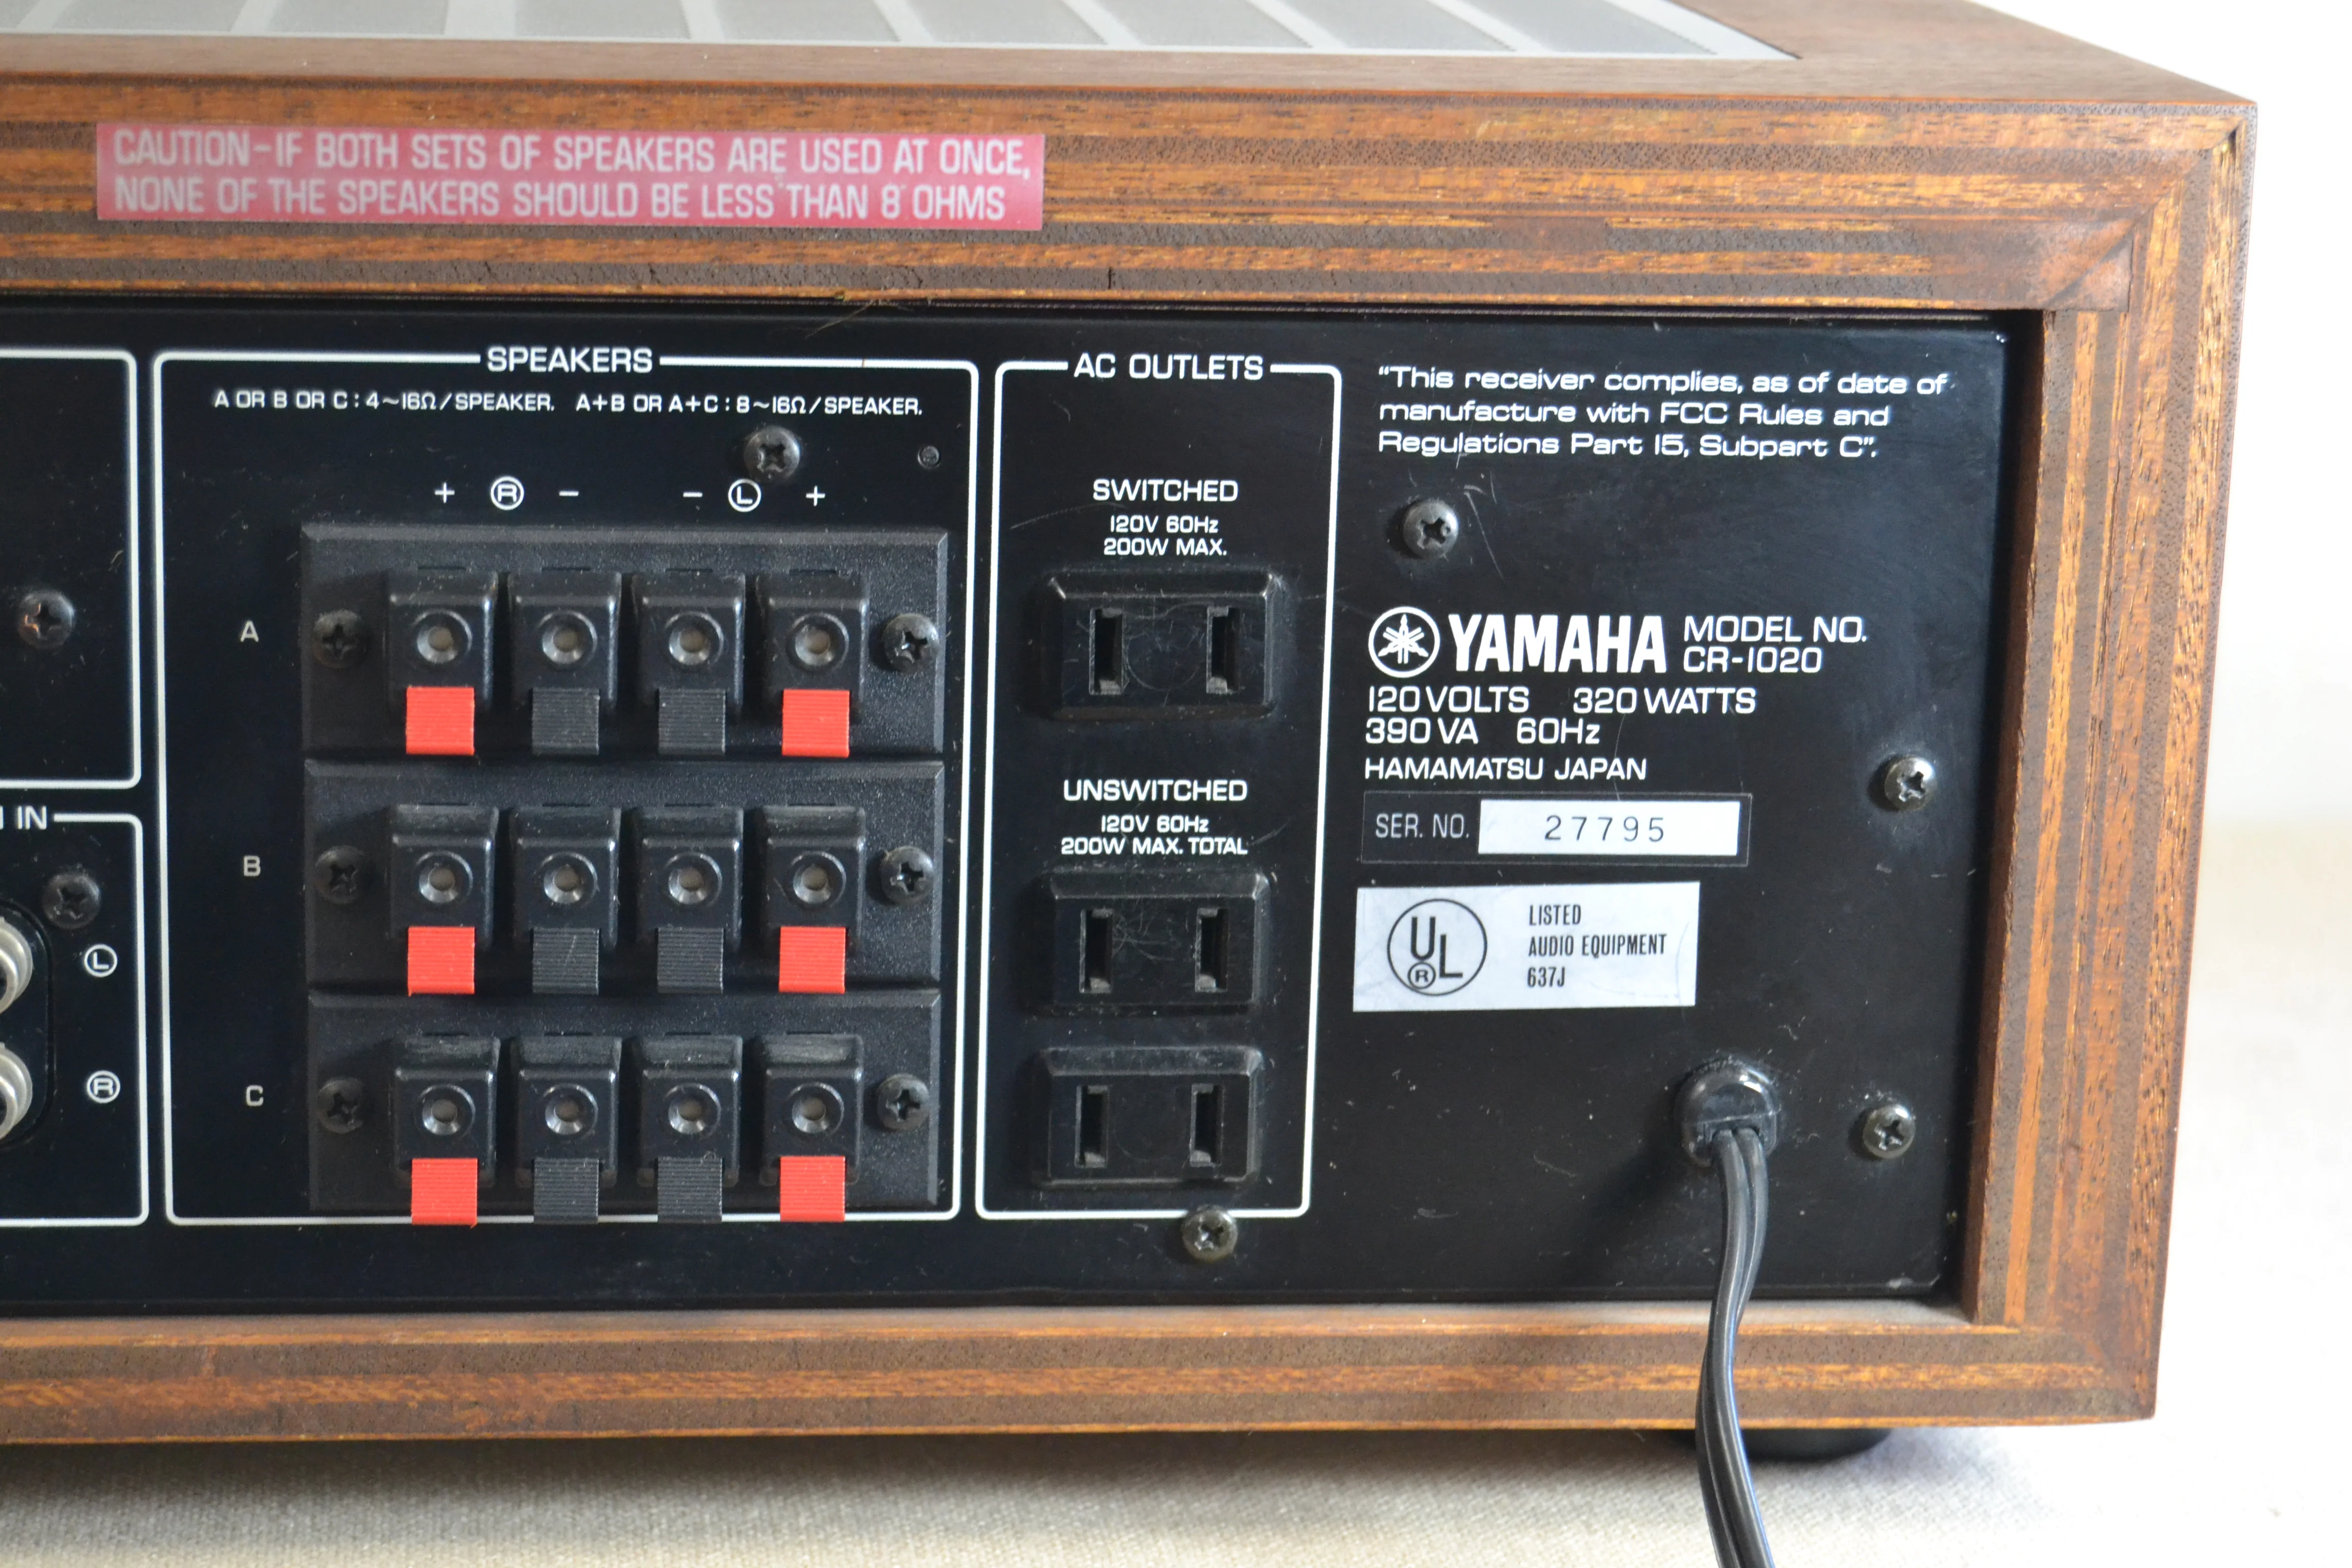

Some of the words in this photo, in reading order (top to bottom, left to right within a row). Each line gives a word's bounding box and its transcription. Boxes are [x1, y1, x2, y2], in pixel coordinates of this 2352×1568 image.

[315, 132, 398, 169] BOTH
[411, 133, 487, 170] SETS
[499, 134, 541, 171] OF
[554, 135, 715, 174] SPEAKERS
[727, 137, 787, 176] ARE
[800, 137, 883, 175] USED
[893, 138, 929, 174] AT
[940, 139, 1031, 181] ONCE,
[114, 175, 205, 213] NONE
[215, 176, 258, 213] OF
[266, 176, 327, 214] THE
[337, 178, 500, 216] SPEAKERS
[513, 181, 639, 217] SHOULD
[651, 182, 690, 218] BE
[701, 182, 774, 218] LESS
[785, 182, 868, 219] THAN
[913, 183, 1006, 220] OHMS
[487, 346, 653, 373] SPEAKERS
[1073, 352, 1116, 378] AC
[1129, 353, 1263, 380] OUTLETS
[1465, 368, 1595, 390] receiver
[1604, 370, 1744, 395] complies,
[1752, 375, 1789, 393] as
[1798, 371, 1830, 393] of
[1837, 372, 1908, 395] date
[1917, 373, 1949, 395] of
[214, 389, 229, 408] A
[235, 389, 265, 408] OR
[273, 390, 287, 408] B
[295, 390, 325, 409] OR
[576, 393, 625, 412] A+B
[633, 394, 663, 412] OR
[1380, 400, 1576, 423] manufacture
[1586, 402, 1650, 423] with
[1660, 402, 1728, 424] FCC
[1739, 403, 1823, 426] Rules
[1833, 405, 1890, 426] and
[1379, 431, 1560, 460] Regulations
[1571, 432, 1643, 455] Part
[1655, 433, 1689, 458] 15,
[1699, 434, 1828, 460] Subpart
[1093, 478, 1238, 502] SWITCHED
[1110, 514, 1159, 533] 120V
[1166, 515, 1218, 533] 60Hz
[1104, 537, 1169, 556] 200W
[1176, 537, 1227, 556] MAX.
[240, 620, 259, 642] A
[1684, 615, 1802, 642] MODEL
[1813, 616, 1867, 643] NO.
[1448, 614, 1667, 673] YAMAHA
[1683, 646, 1822, 673] CR-1020
[1369, 685, 1420, 713] 120
[1425, 685, 1529, 713] VOLTS
[1573, 687, 1637, 714] 320
[1644, 687, 1756, 714] WATTS
[1365, 717, 1431, 744] 390
[1437, 717, 1479, 744] VA
[1516, 717, 1600, 745] 60Hz
[1365, 757, 1544, 780] HAMAMATSU
[1554, 757, 1647, 780] JAPAN
[1063, 779, 1247, 801] UNSWITCHED
[16, 805, 47, 830] IN
[1101, 815, 1149, 833] 120V
[1157, 815, 1209, 833] 60Hz
[1376, 813, 1423, 838] SER.
[1432, 813, 1469, 839] NO.
[1544, 815, 1664, 842] 27795
[1061, 837, 1126, 855] 200W
[1132, 837, 1184, 855] MAX.
[1187, 837, 1248, 855] TOTAL
[243, 855, 261, 877] B
[1529, 904, 1581, 926] LISTED
[1528, 935, 1574, 957] AUDIO
[1581, 934, 1667, 959] EQUIPMENT
[1527, 966, 1565, 988] 637J
[246, 1085, 264, 1107] C
